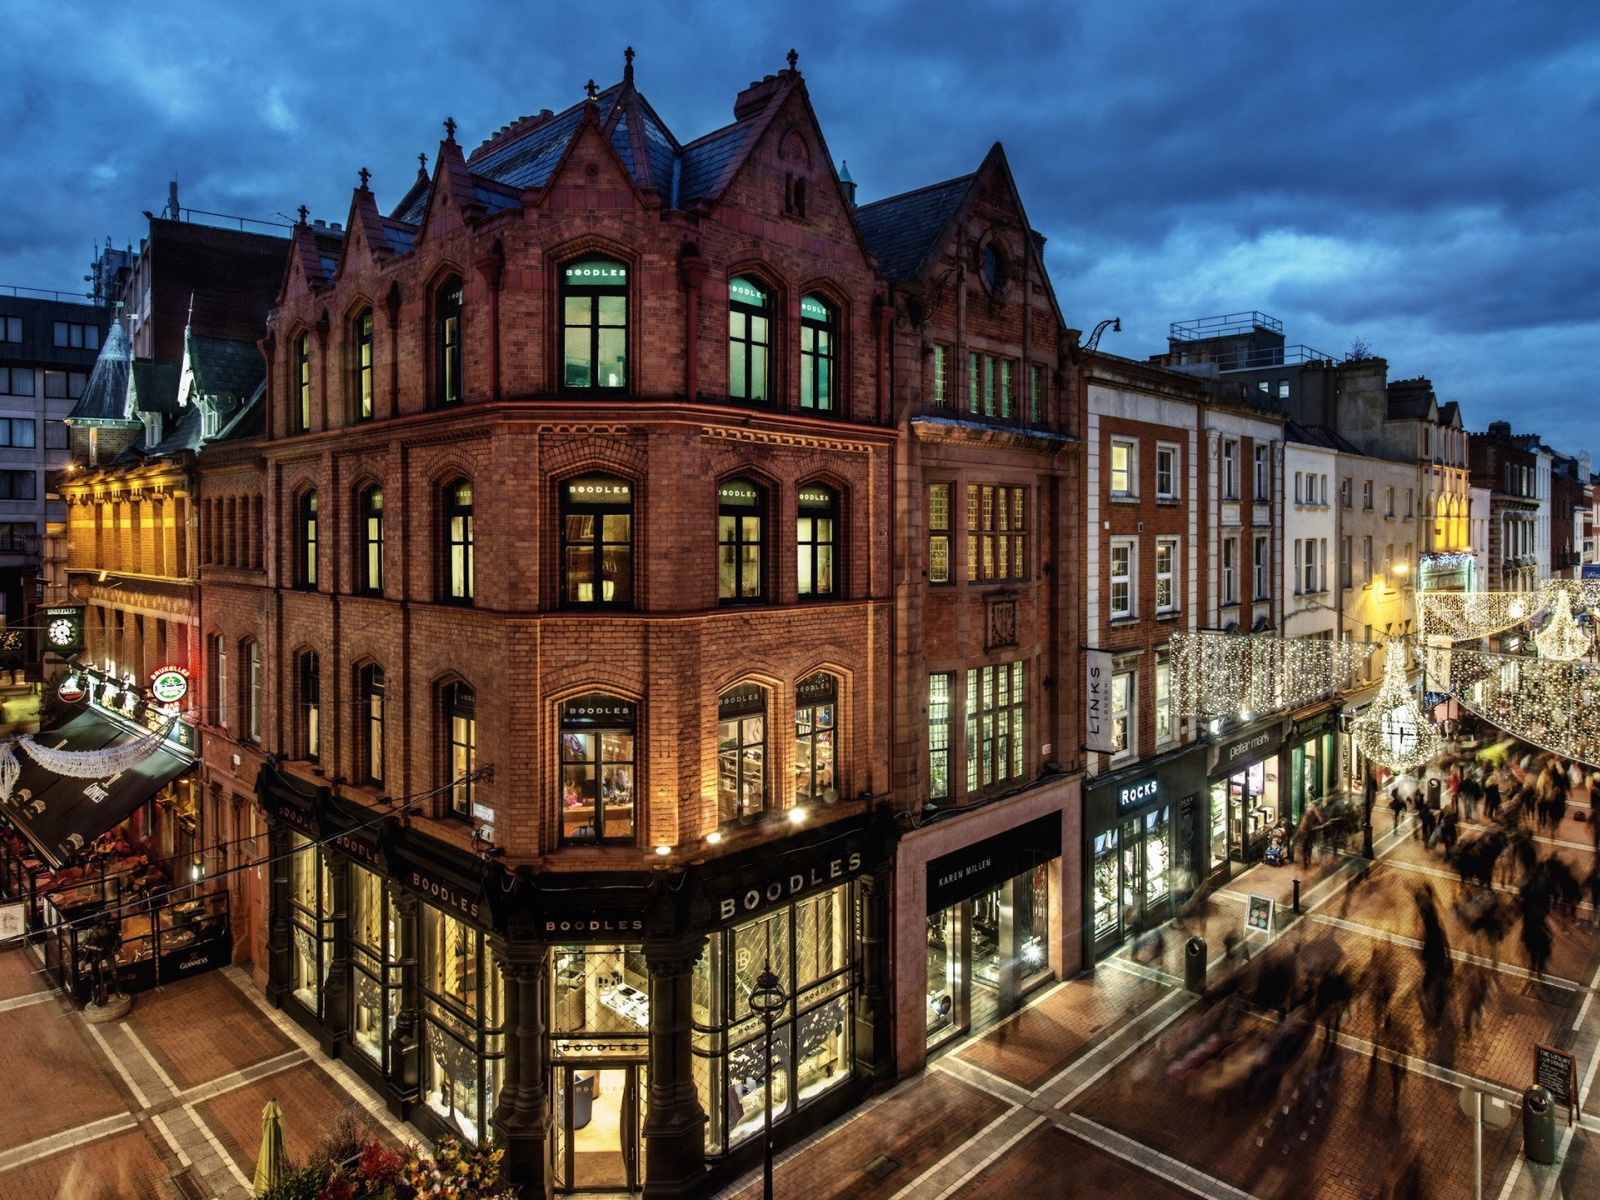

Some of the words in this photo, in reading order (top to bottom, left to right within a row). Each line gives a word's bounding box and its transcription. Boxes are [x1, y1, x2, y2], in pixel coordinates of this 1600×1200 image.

[729, 285, 767, 299] OODLES
[801, 303, 831, 316] OODLES
[799, 493, 829, 501] OODLES
[1090, 667, 1100, 734] LINKS
[569, 707, 629, 715] BOODLES
[1230, 741, 1250, 760] peter
[1122, 781, 1157, 805] ROCKS
[939, 870, 963, 887] KAREN
[966, 858, 991, 875] MILLEN
[413, 872, 479, 917] BOODLES
[720, 852, 861, 920] BOODLES
[545, 921, 643, 931] BOODLES
[804, 980, 841, 1002] BOODLES
[562, 1044, 639, 1052] BOODLES
